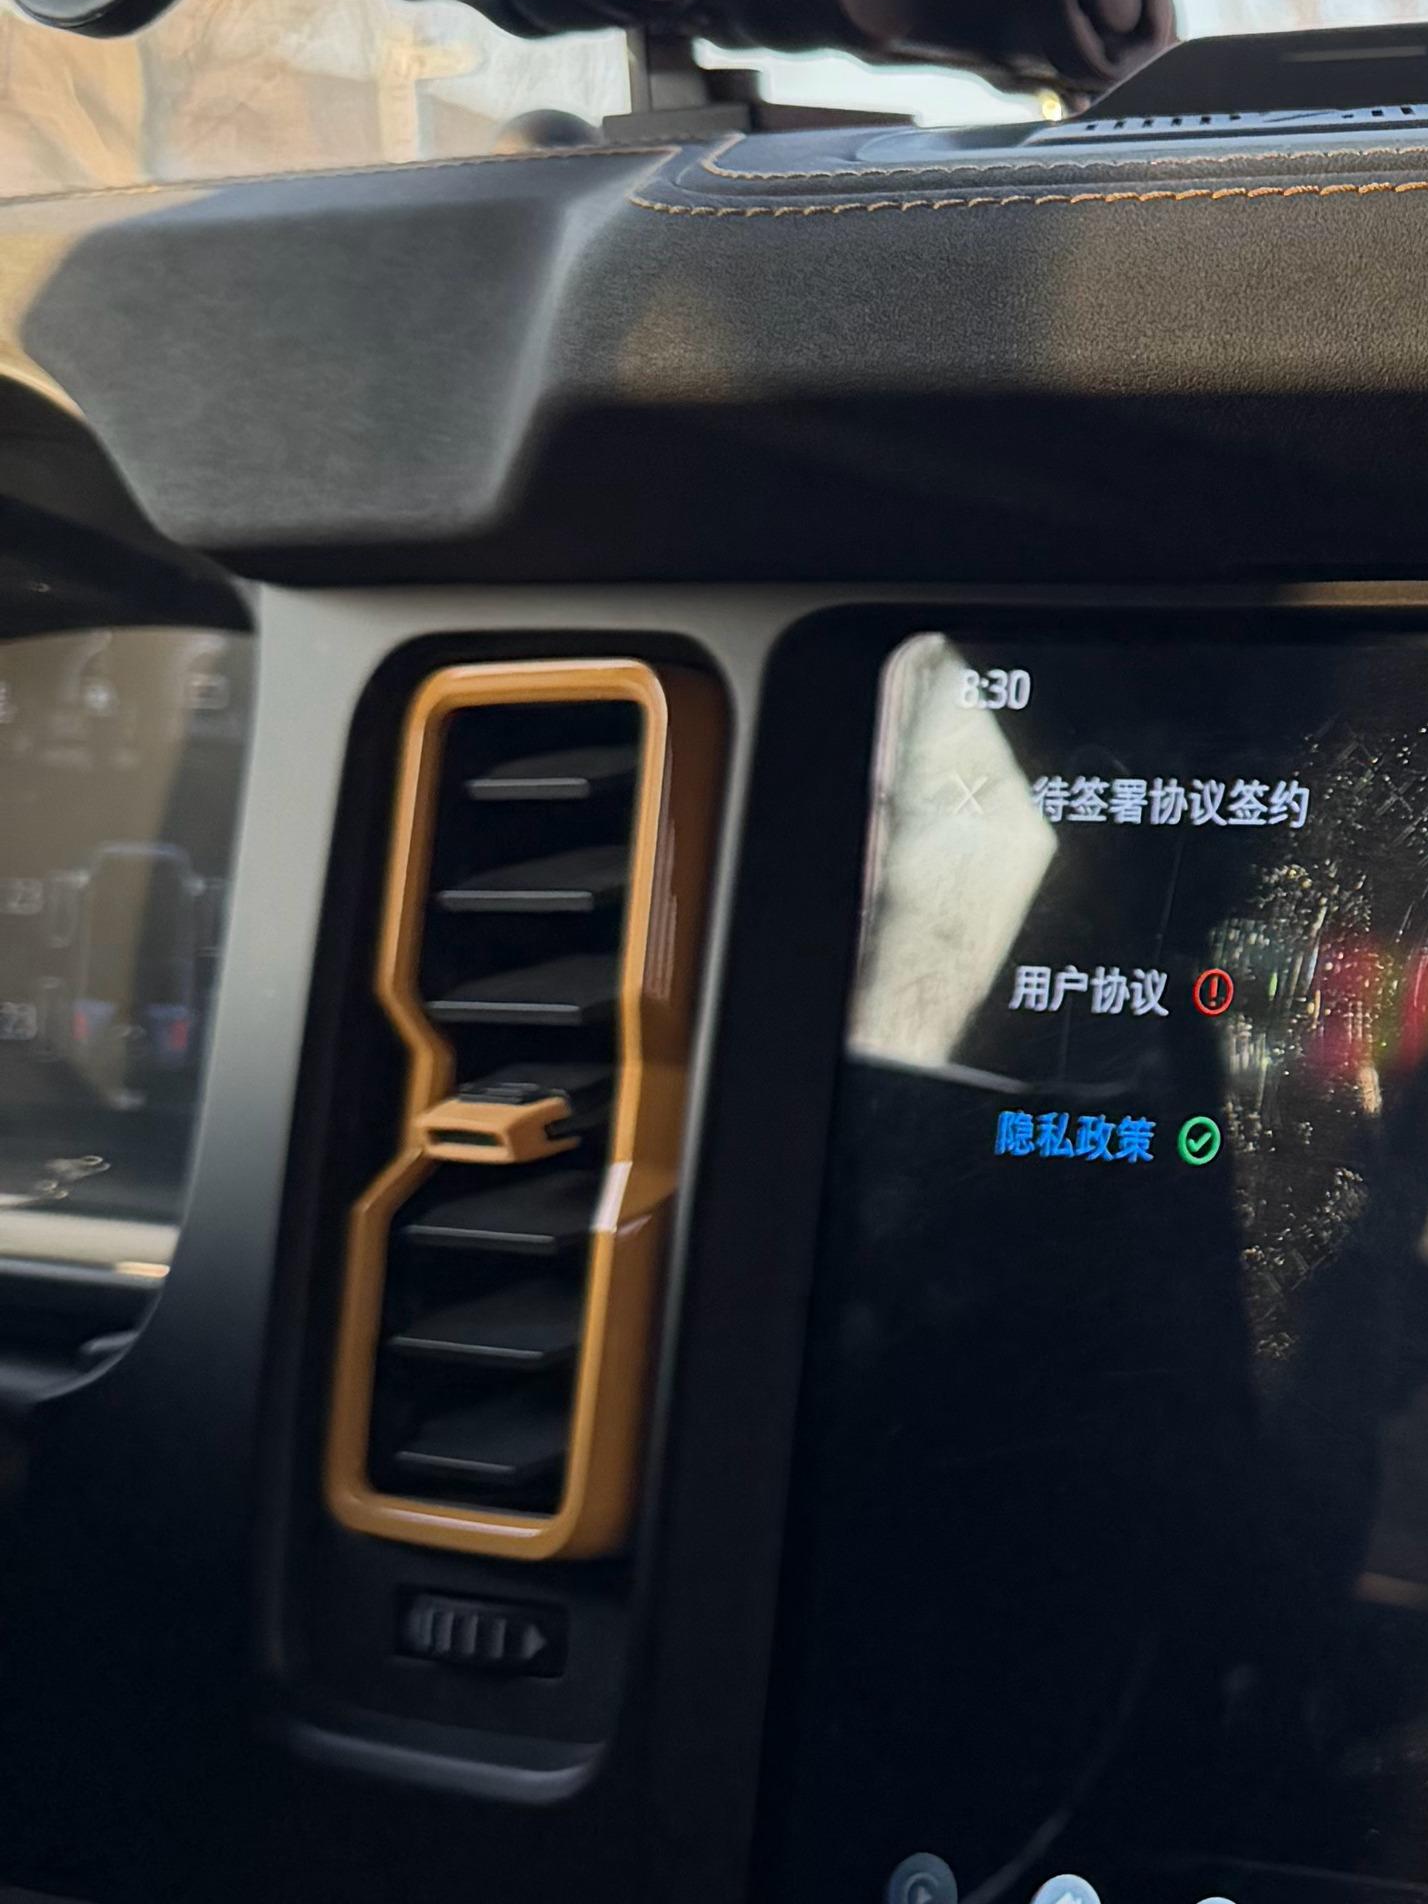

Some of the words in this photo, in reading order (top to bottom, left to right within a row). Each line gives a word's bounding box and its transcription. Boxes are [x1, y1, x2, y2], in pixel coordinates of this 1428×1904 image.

[1033, 775, 1311, 829] 待签署协议签约
[1009, 965, 1169, 1017] 用户协议
[994, 1109, 1157, 1164] 隐私政策
